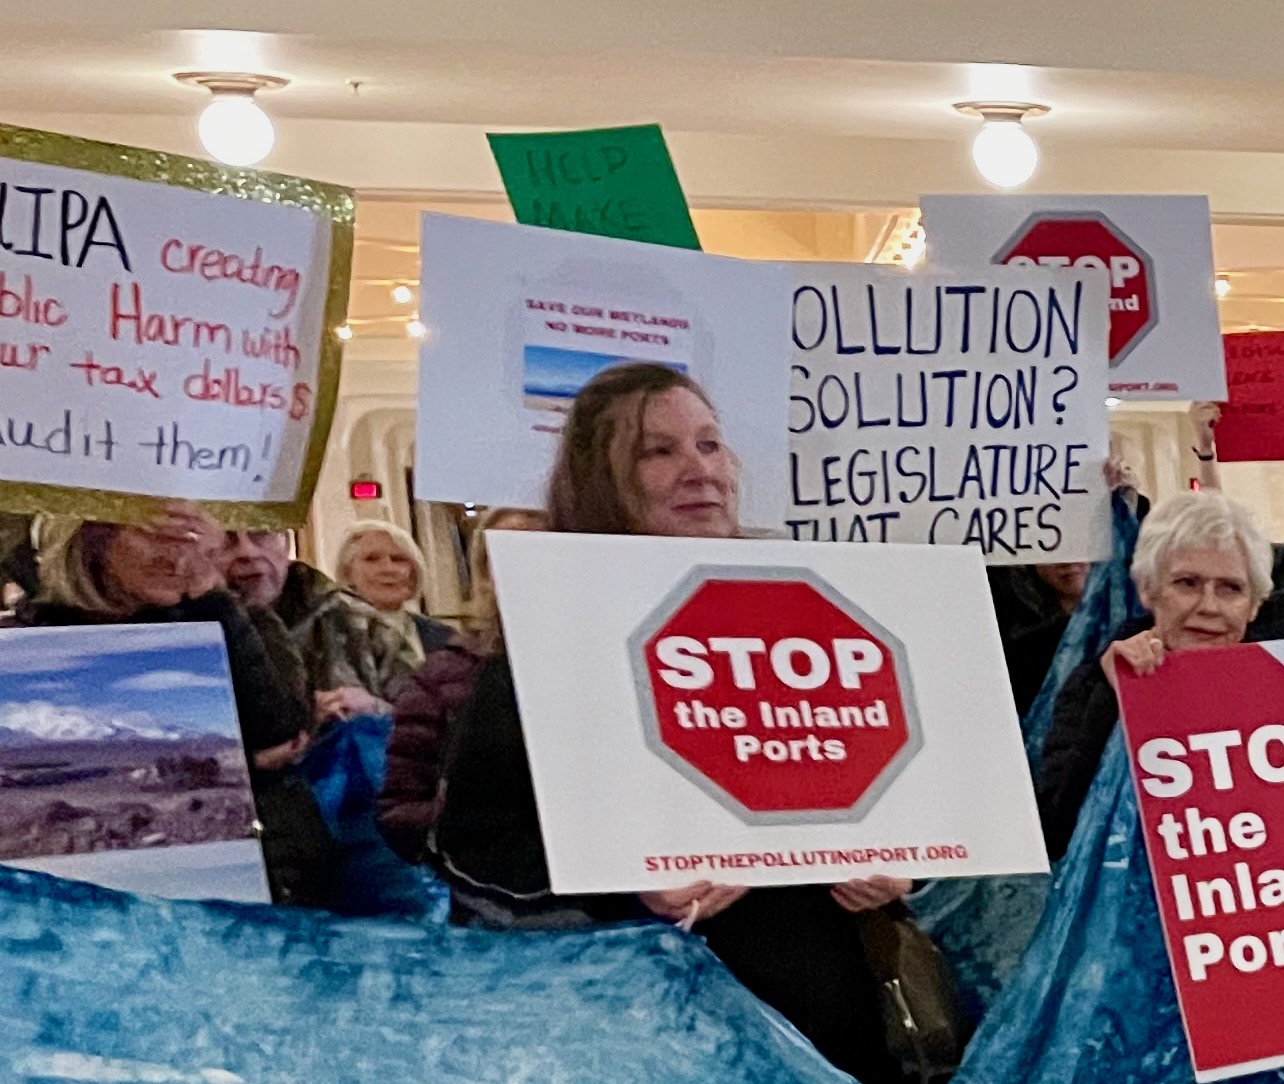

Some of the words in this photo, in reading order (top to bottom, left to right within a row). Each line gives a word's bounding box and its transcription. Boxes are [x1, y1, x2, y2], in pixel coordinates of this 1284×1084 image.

[109, 282, 232, 351] Harm
[242, 328, 301, 370] with
[571, 304, 603, 318] OUR
[791, 279, 1084, 358] OLLUTION
[69, 350, 161, 398] tax
[787, 364, 1079, 434] SOLUTION?
[0, 408, 118, 462] udit
[139, 421, 272, 483] them!
[789, 443, 1089, 506] LEGISLATURE
[929, 504, 1064, 555] CARES
[654, 636, 884, 691] STOP
[673, 699, 747, 731] the
[761, 700, 889, 731] Inland
[733, 734, 846, 763] Ports
[645, 844, 969, 873] STOPTHEPOLLUTINGPORT.ORG
[1157, 806, 1267, 861] the
